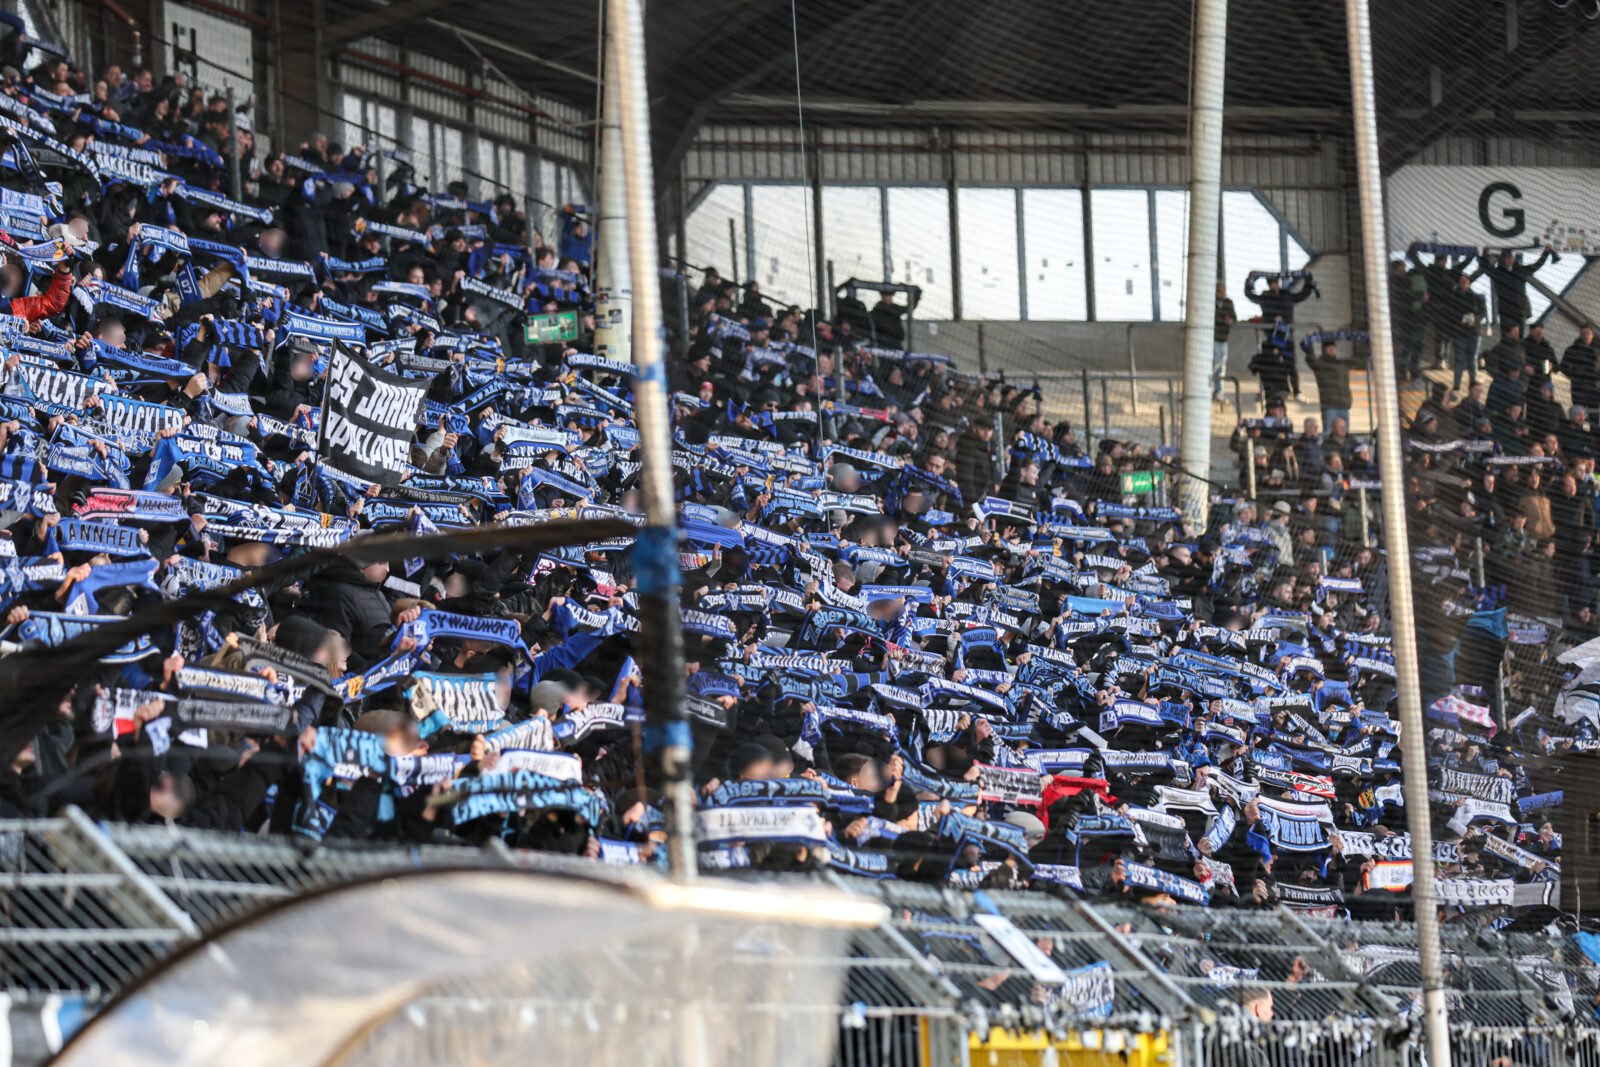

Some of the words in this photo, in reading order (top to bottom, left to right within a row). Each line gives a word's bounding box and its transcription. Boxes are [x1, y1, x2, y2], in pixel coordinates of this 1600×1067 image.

[1478, 181, 1526, 238] G
[277, 260, 311, 275] FOOTBALL
[429, 613, 444, 629] SV
[449, 614, 506, 635] WALDHOF
